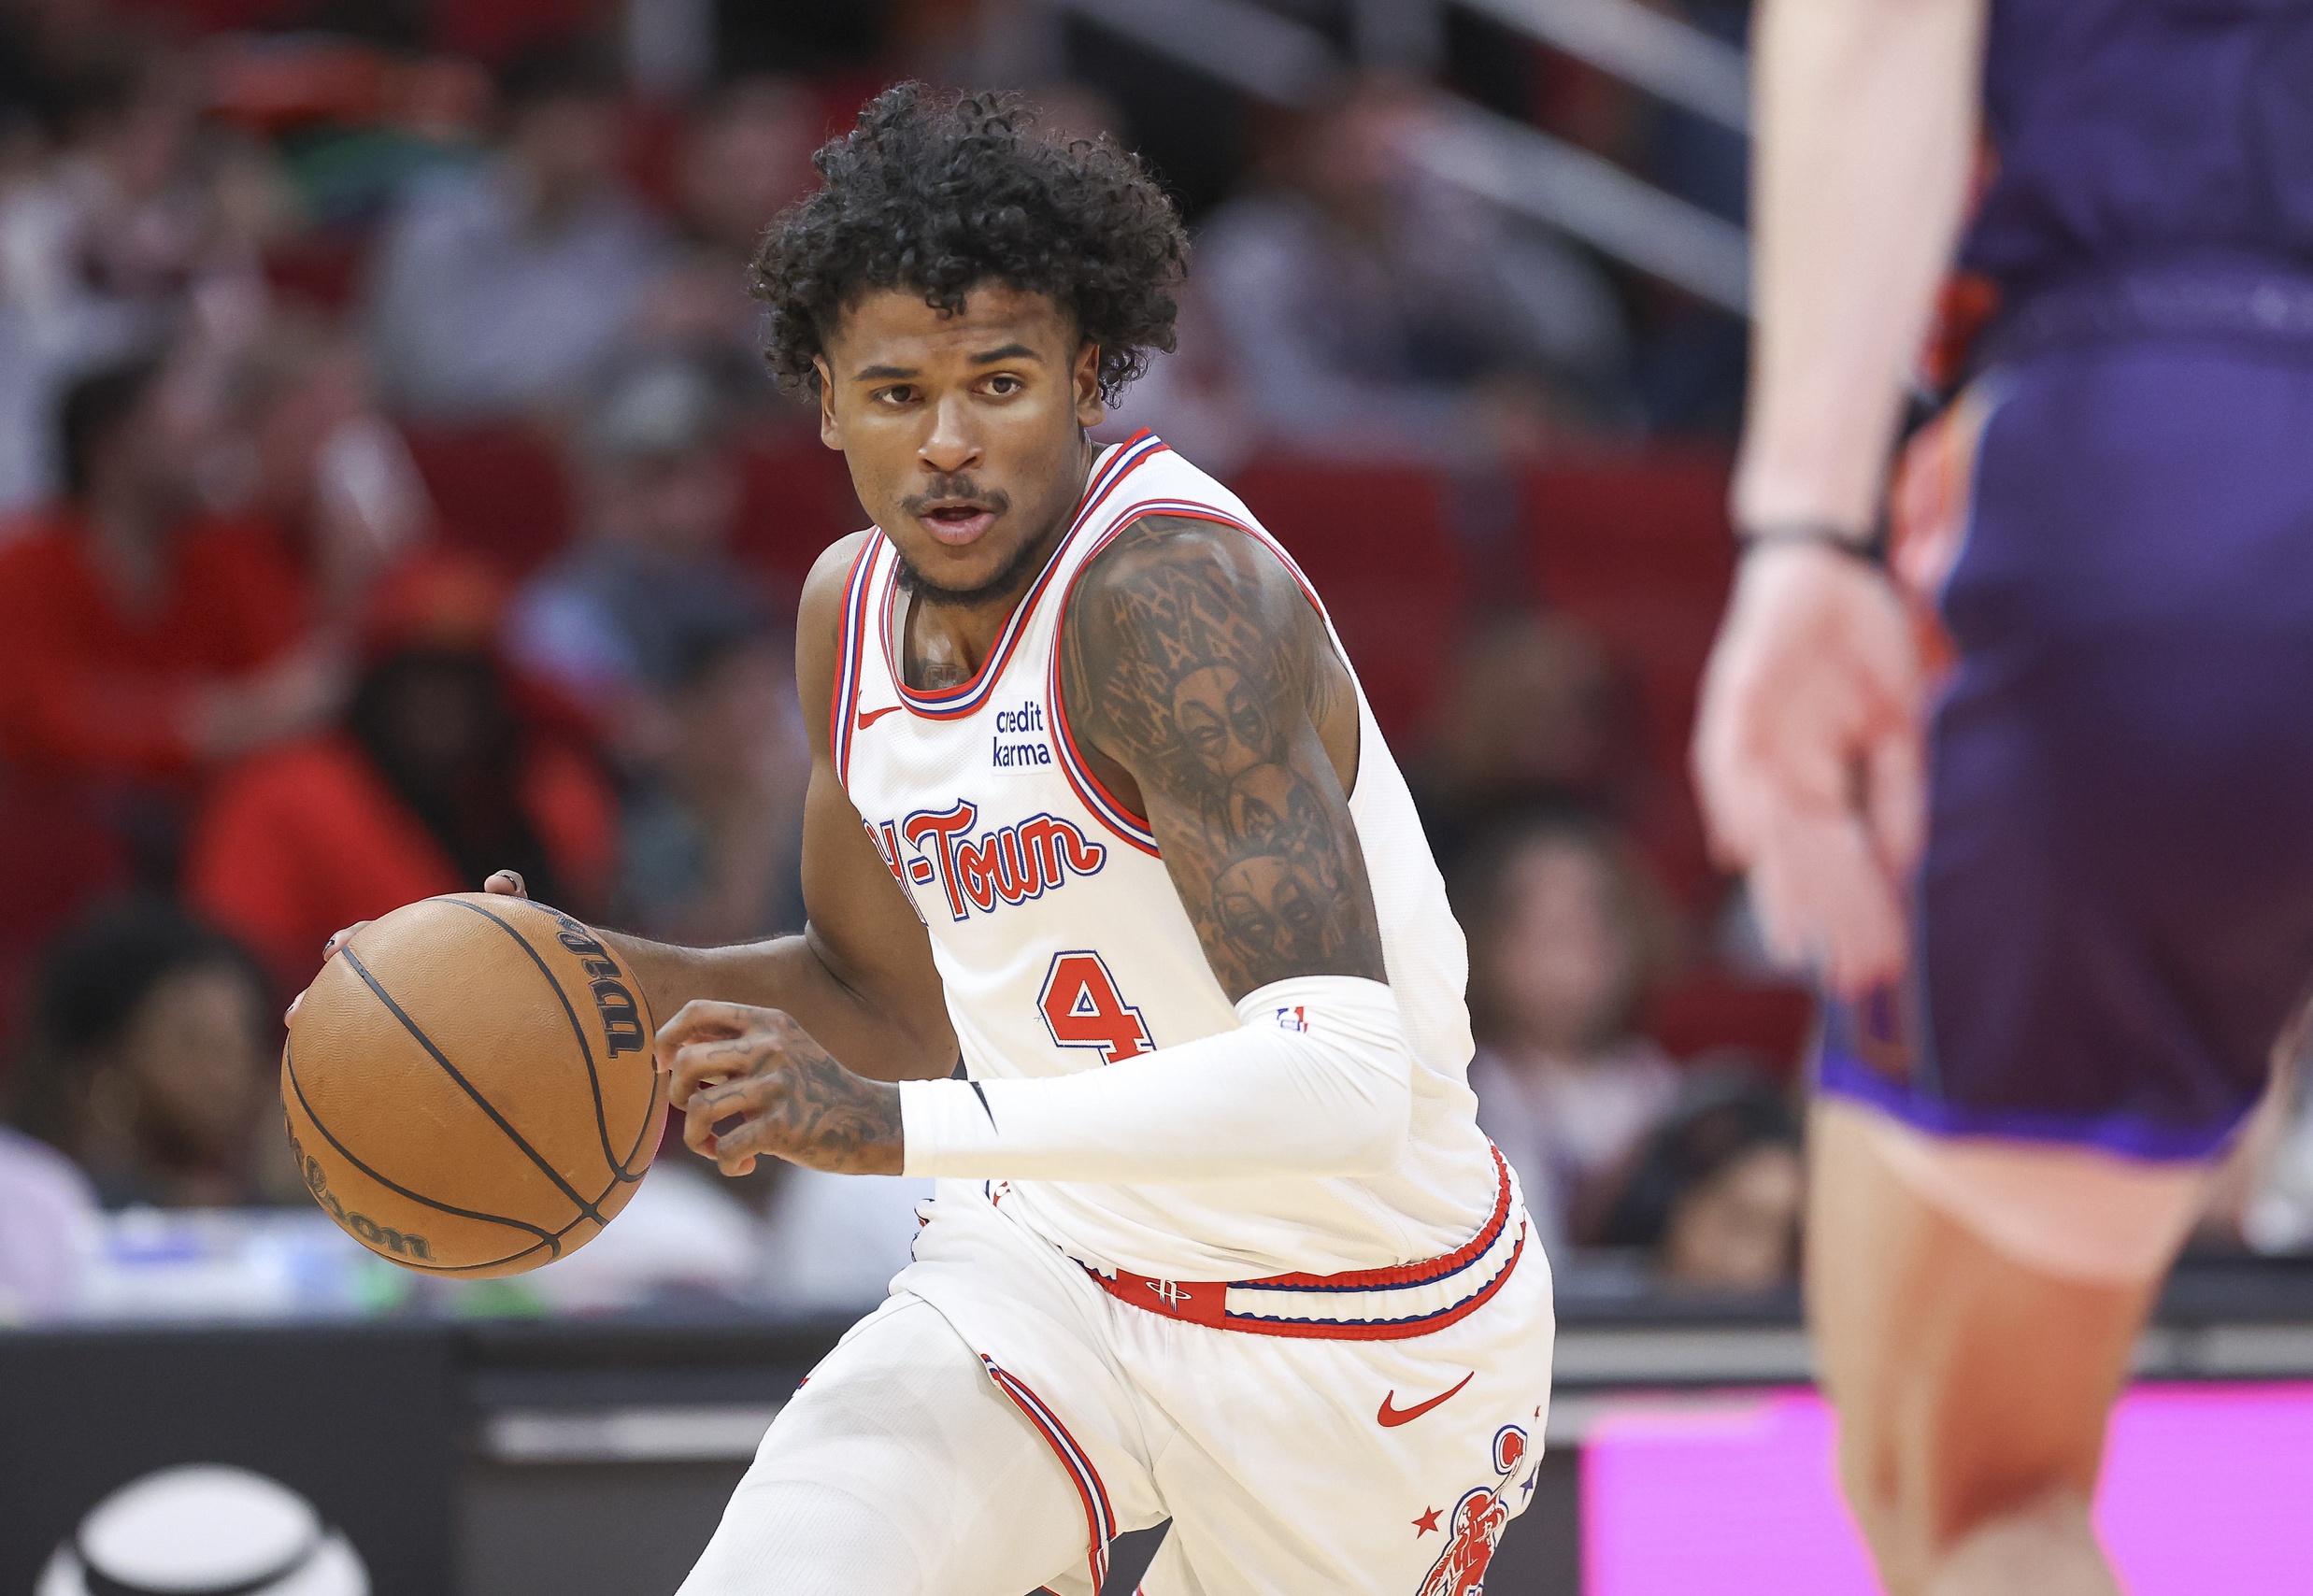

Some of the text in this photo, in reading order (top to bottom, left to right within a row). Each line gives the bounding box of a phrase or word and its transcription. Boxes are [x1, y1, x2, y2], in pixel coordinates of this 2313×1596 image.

[996, 701, 1044, 734] credit
[992, 735, 1051, 767] karma
[1036, 949, 1158, 1067] 4
